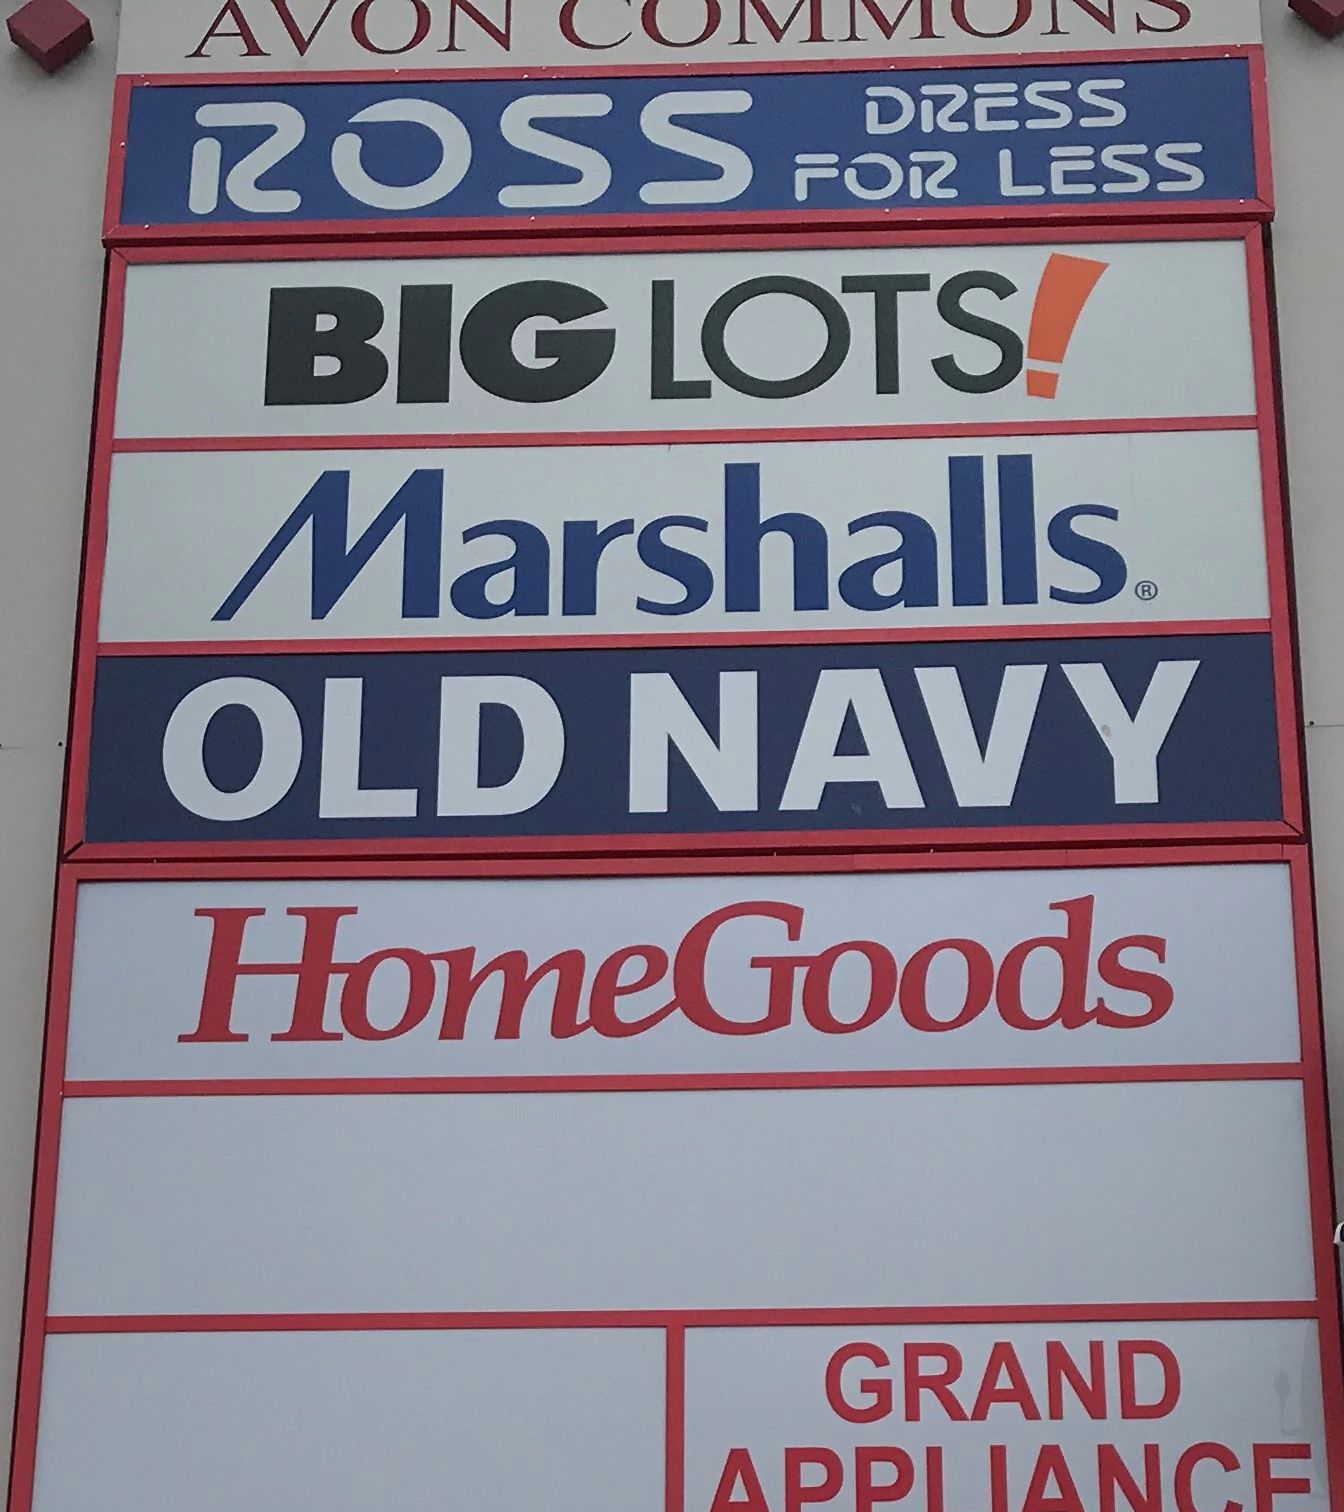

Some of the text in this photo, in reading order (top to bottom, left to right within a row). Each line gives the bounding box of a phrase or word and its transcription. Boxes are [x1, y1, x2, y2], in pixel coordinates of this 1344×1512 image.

[184, 0, 511, 57] AVON
[188, 91, 754, 214] ROSS
[864, 79, 1127, 135] DRESS
[794, 142, 1205, 202] FOR LESS
[263, 252, 1110, 407] BIG LOTS!
[210, 454, 1129, 622] Marshalls
[161, 659, 1201, 821] OLD NAVY
[177, 895, 1175, 1044] HomeGoods
[823, 1339, 1181, 1425] GRAND
